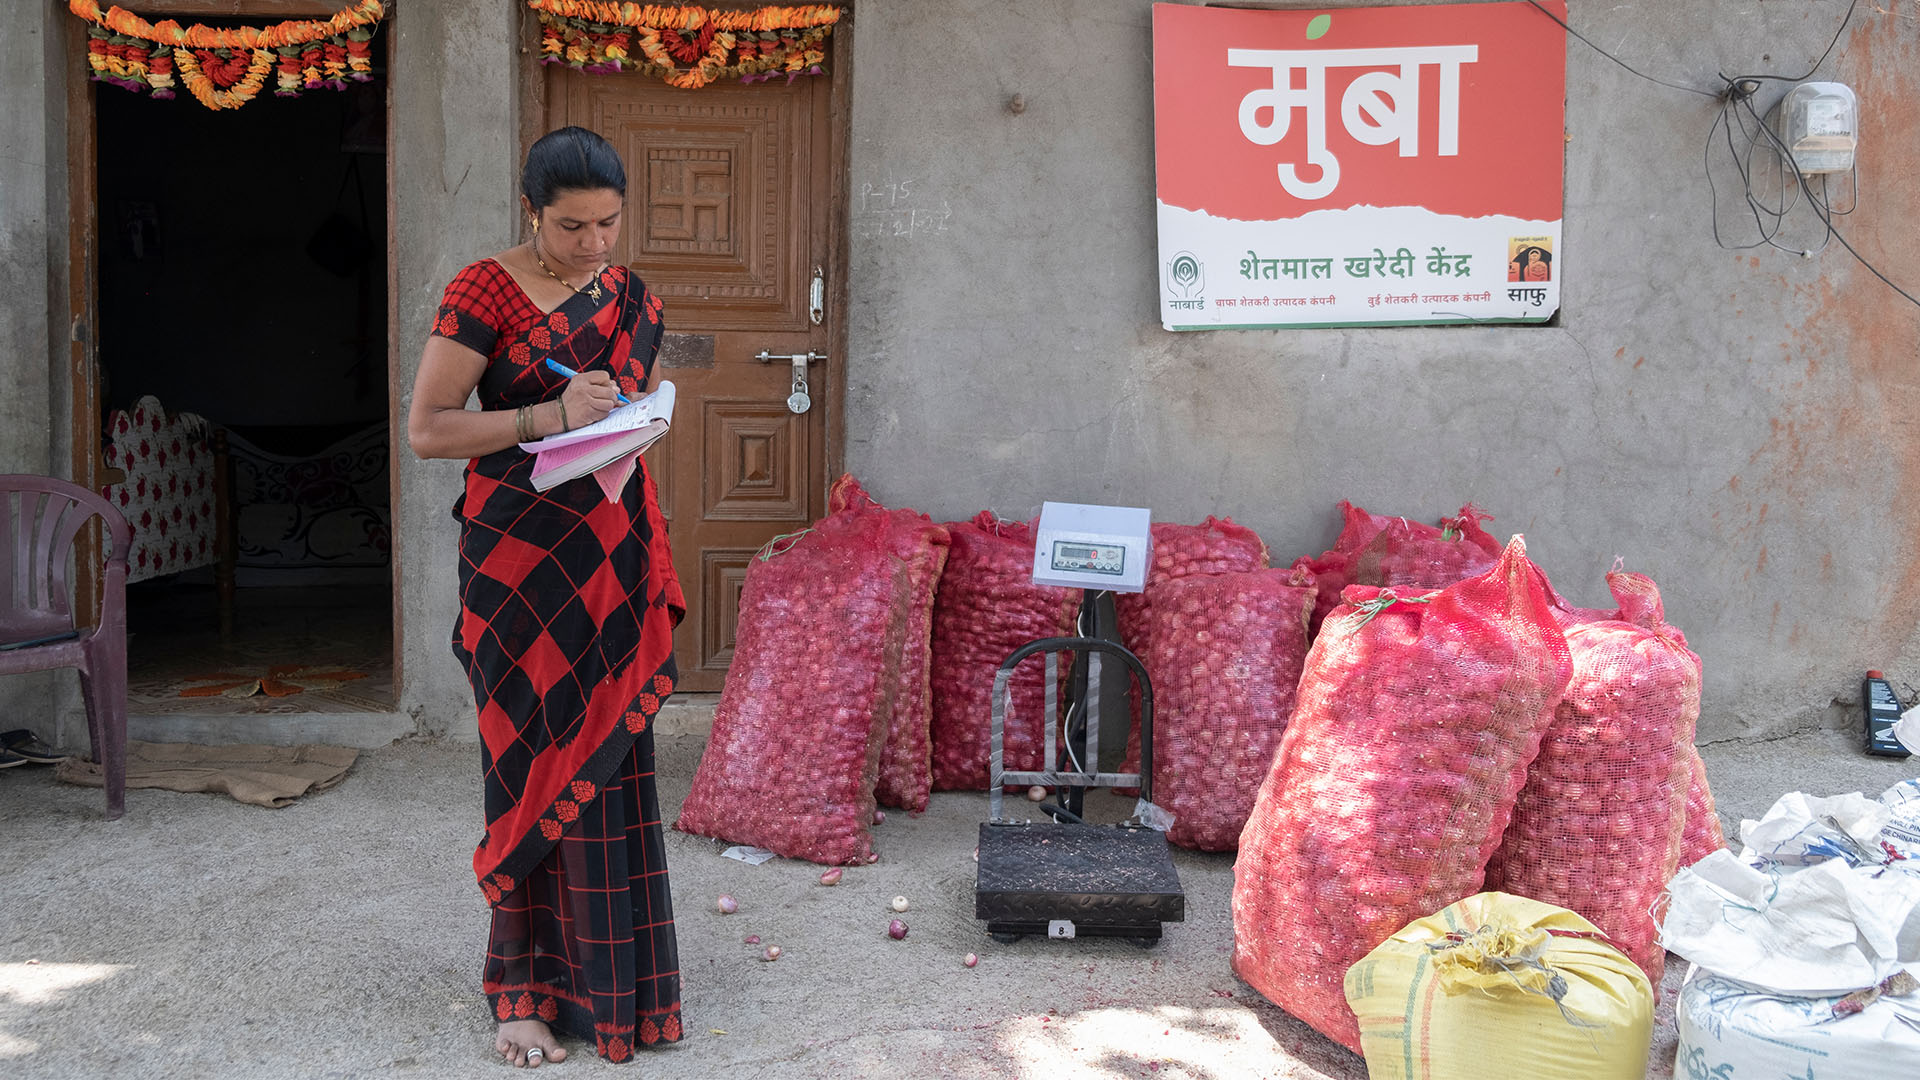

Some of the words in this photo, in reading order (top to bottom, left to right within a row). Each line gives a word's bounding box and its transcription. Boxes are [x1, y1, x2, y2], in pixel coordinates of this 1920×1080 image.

[1228, 14, 1479, 200] मुंबा
[1240, 250, 1334, 280] शेतमाल
[1344, 248, 1416, 279] खरेदी
[1425, 246, 1473, 277] केंद्र
[1169, 296, 1205, 311] नाबार्ड
[1240, 295, 1270, 307] शेतकरी
[1273, 297, 1307, 306] उत्पादक
[1310, 294, 1336, 306] कंपनी
[1384, 293, 1419, 305] शेतकरी
[1422, 294, 1460, 304] उत्पादक
[1463, 291, 1492, 303] कंपनी
[1507, 287, 1548, 306] साफु
[1058, 926, 1065, 936] 8
